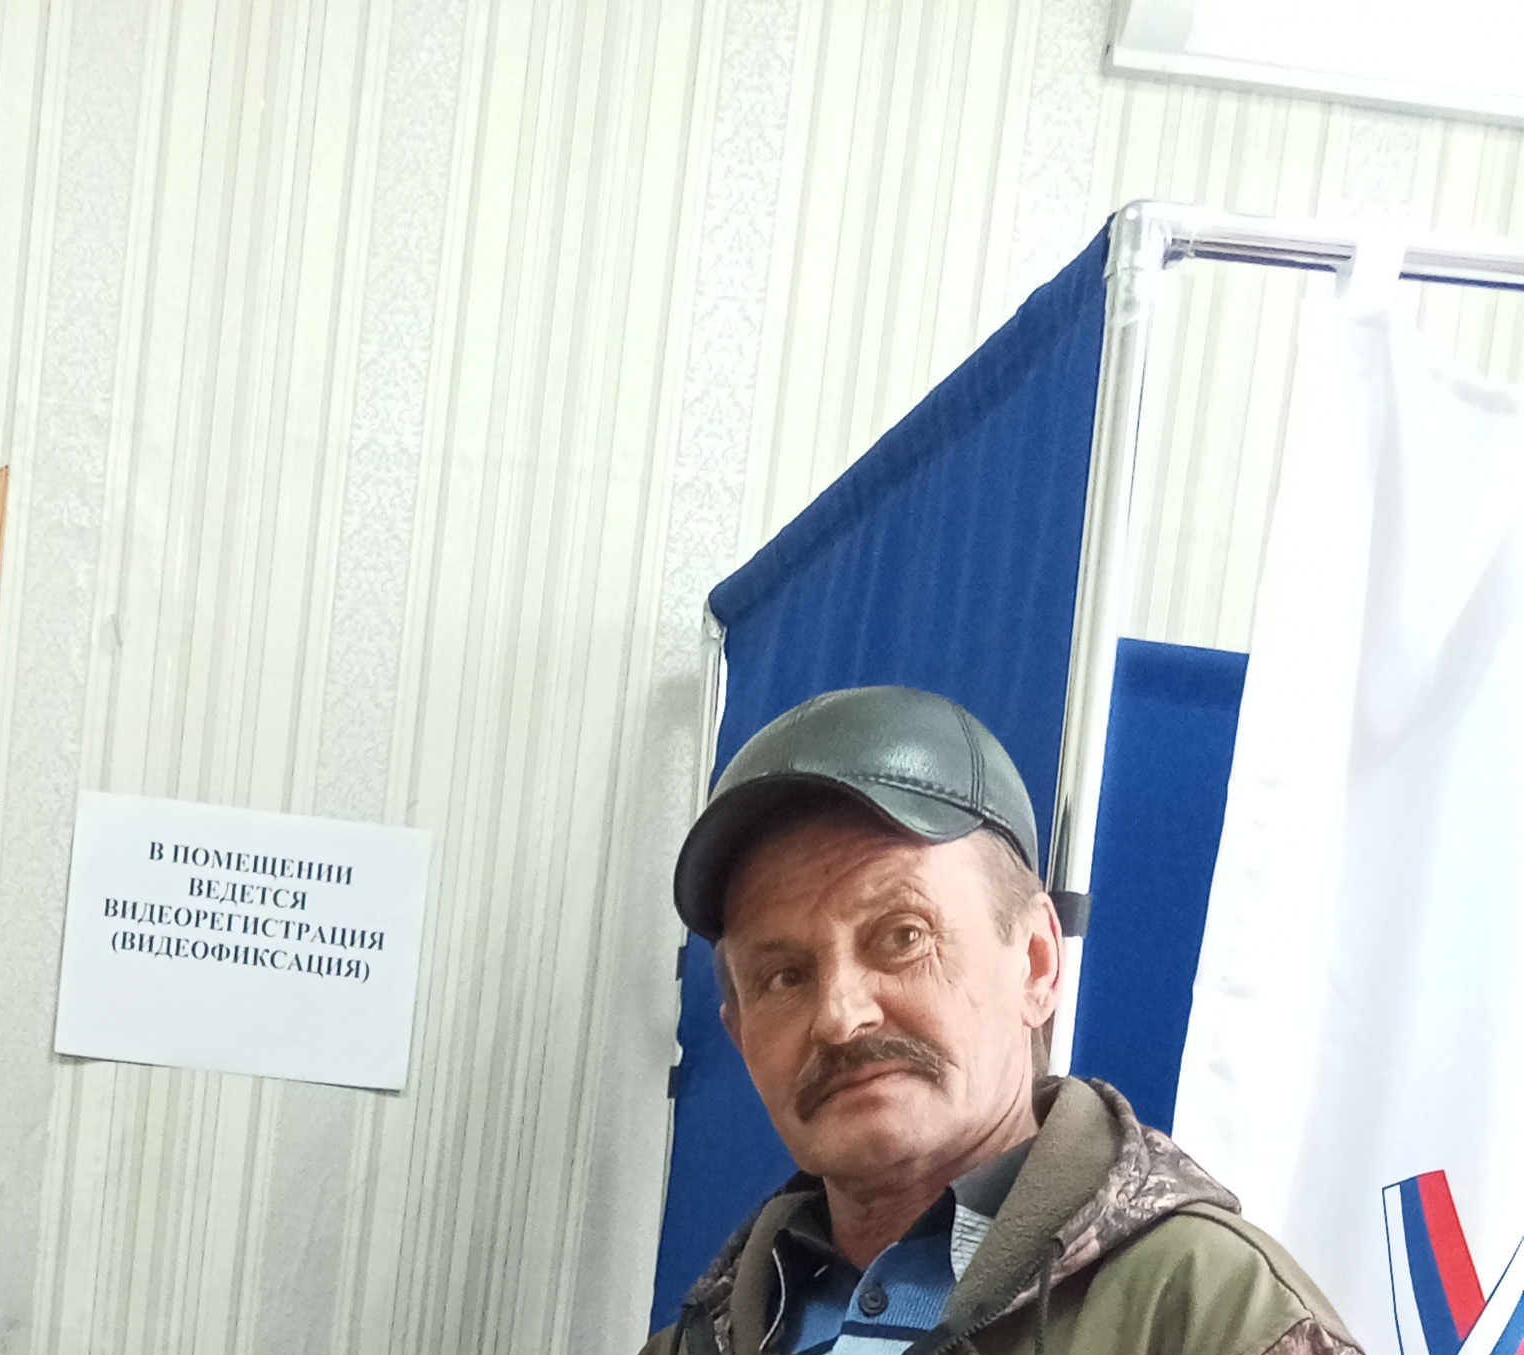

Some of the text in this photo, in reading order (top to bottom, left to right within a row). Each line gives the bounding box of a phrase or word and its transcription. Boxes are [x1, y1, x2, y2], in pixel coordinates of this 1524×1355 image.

[149, 841, 354, 886] В ПОМЕЩЕНИИ
[188, 877, 309, 911] ВЕДЕТСЯ
[103, 898, 385, 951] ВИДЕОРЕГИСТРАЦИЯ
[111, 930, 371, 984] (ВИДЕОФИКСАЦИЯ)
